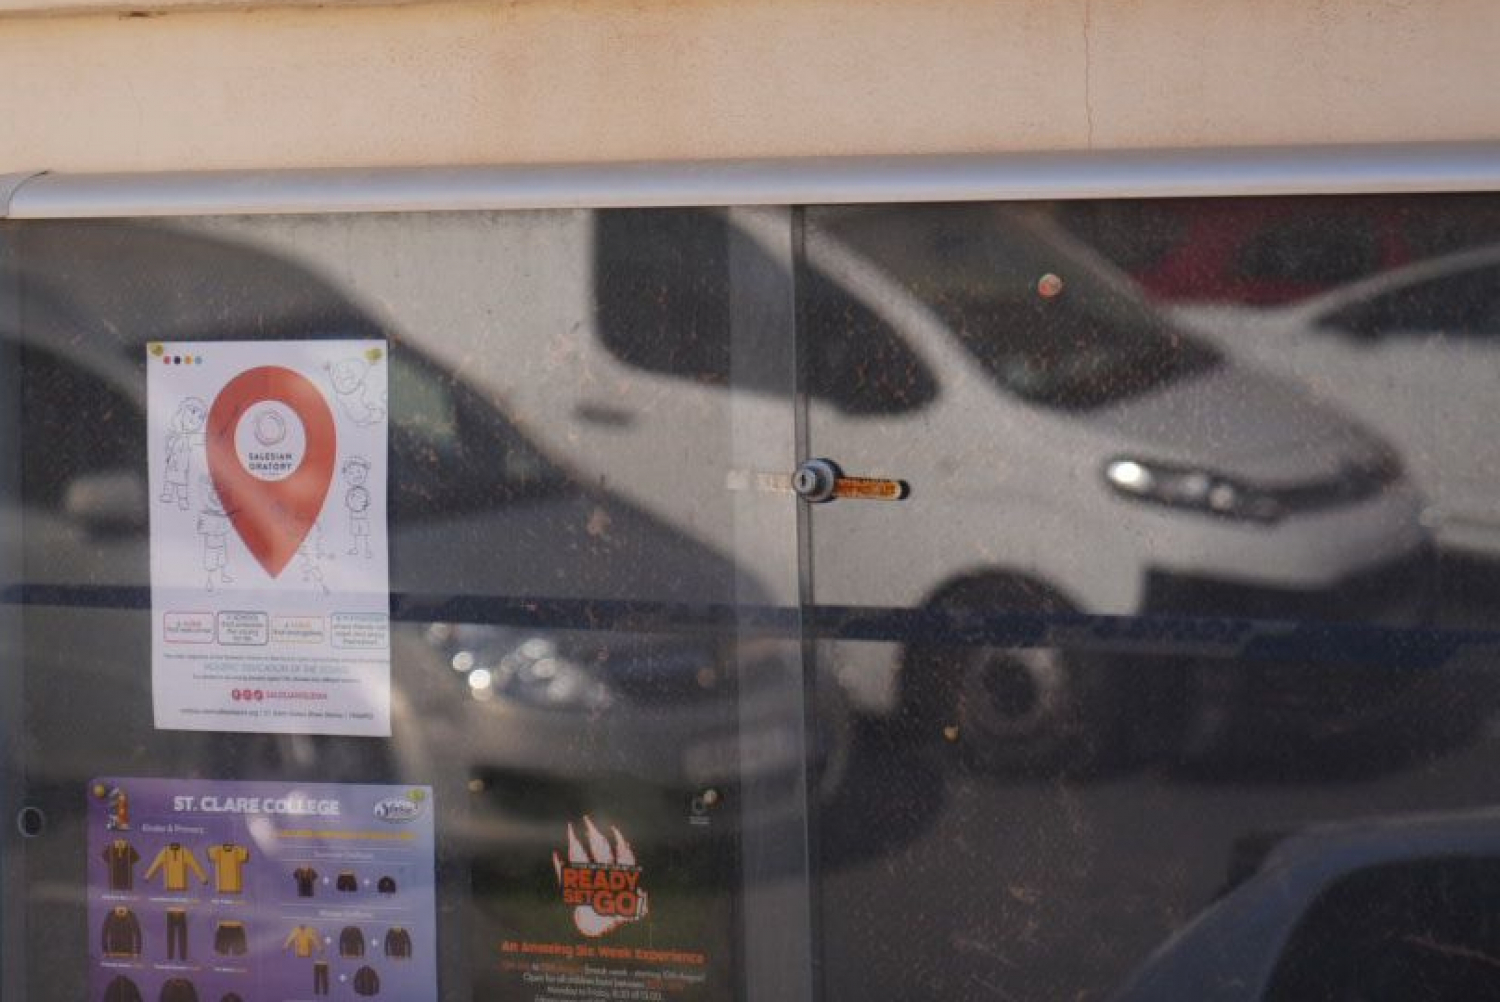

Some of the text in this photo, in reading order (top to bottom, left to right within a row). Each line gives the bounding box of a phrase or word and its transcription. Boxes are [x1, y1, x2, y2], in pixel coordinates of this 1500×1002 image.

[248, 452, 293, 461] SALESIAN
[248, 462, 293, 471] ORATORY
[173, 795, 341, 816] ST. CLARE COLLEGE
[562, 868, 640, 890] READY
[593, 890, 639, 917] GO
